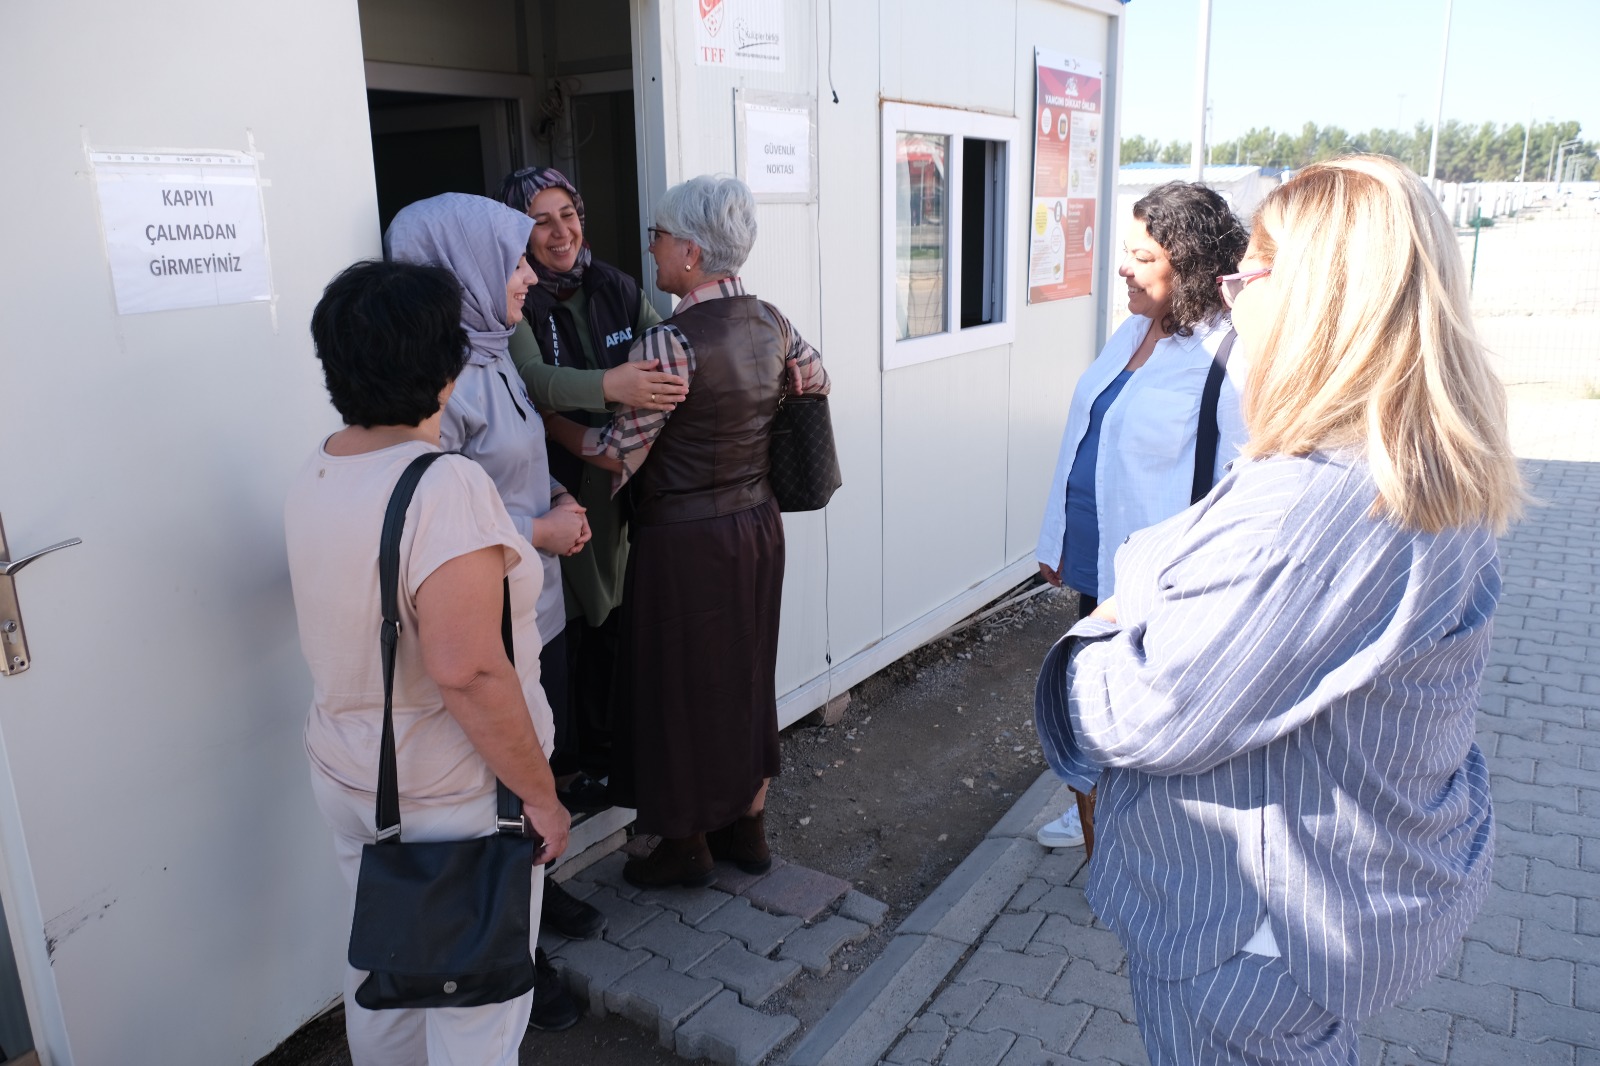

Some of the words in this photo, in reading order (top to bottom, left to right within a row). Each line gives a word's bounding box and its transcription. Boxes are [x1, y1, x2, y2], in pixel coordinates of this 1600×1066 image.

[701, 46, 726, 63] TFF
[764, 142, 796, 155] GÜVENLİK
[766, 164, 794, 174] NOKTASI
[162, 189, 214, 206] KAPIYI
[145, 224, 236, 245] ÇALMADAN
[150, 253, 242, 277] GİRMEYİNİZ
